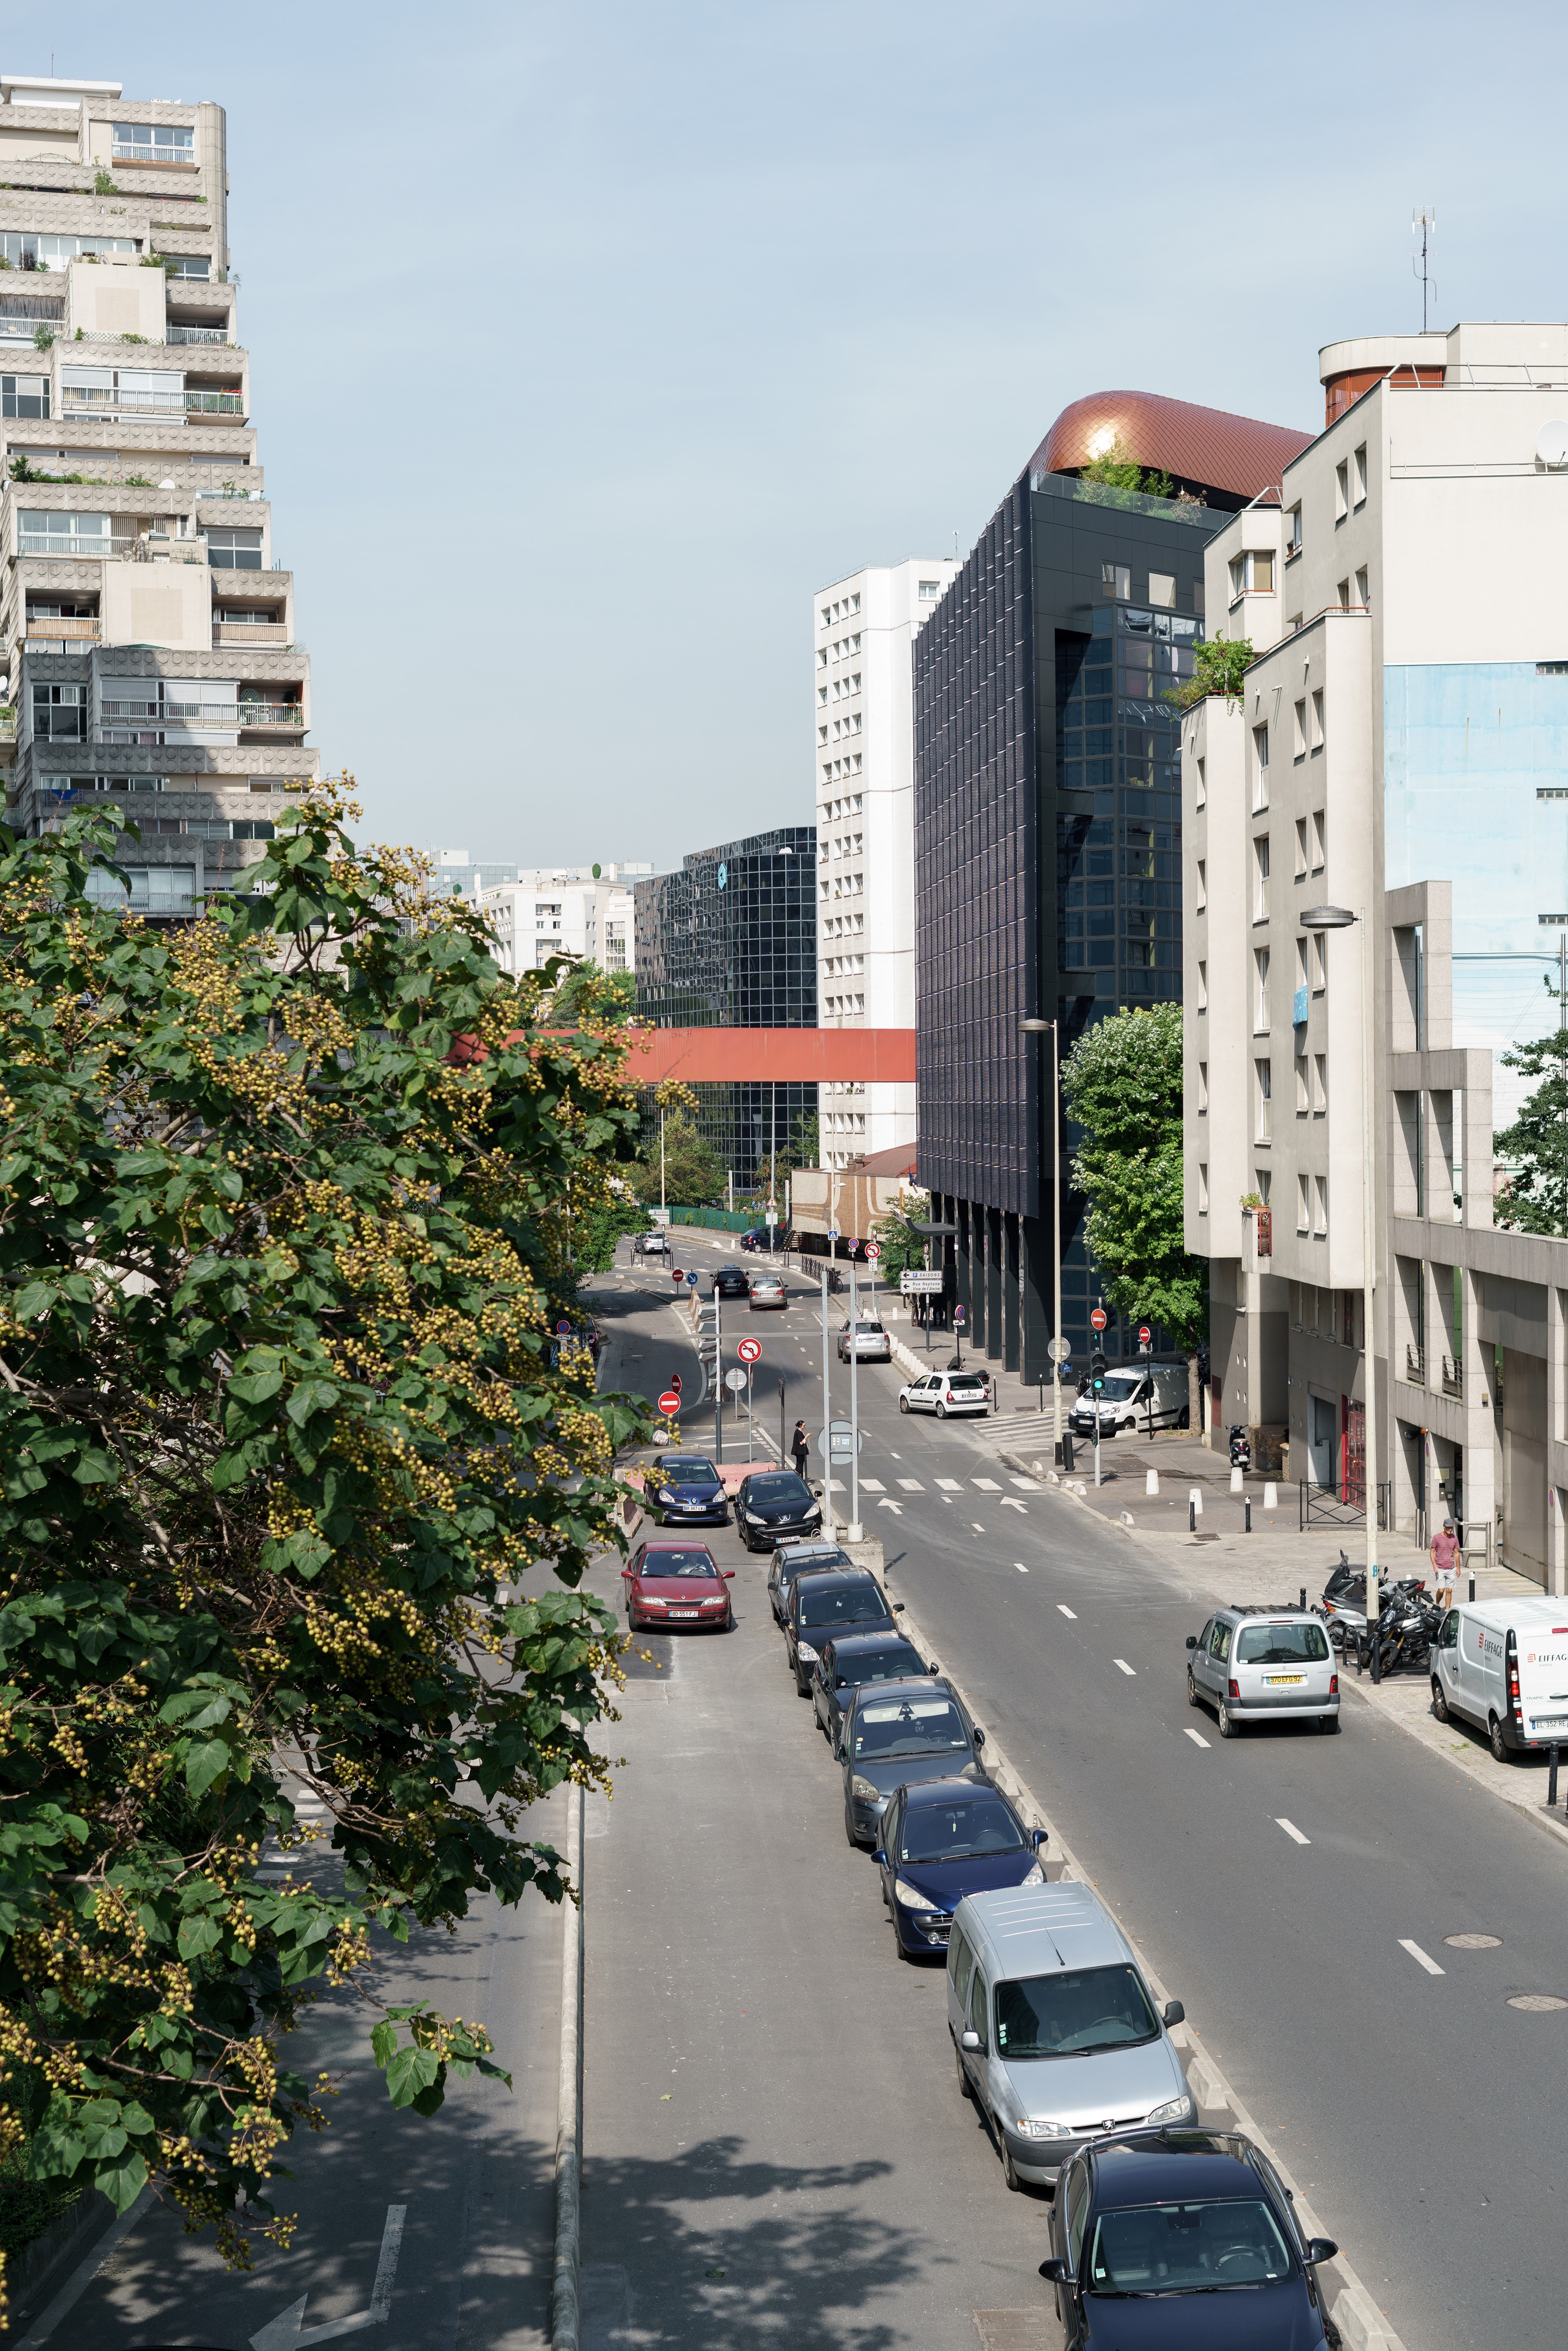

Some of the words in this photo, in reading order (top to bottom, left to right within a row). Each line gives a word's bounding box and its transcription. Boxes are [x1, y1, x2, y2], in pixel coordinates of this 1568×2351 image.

[671, 1029, 692, 1038] BACH
[1484, 1640, 1503, 1658] EIFFAGE
[1539, 1654, 1568, 1662] EIFFAG
